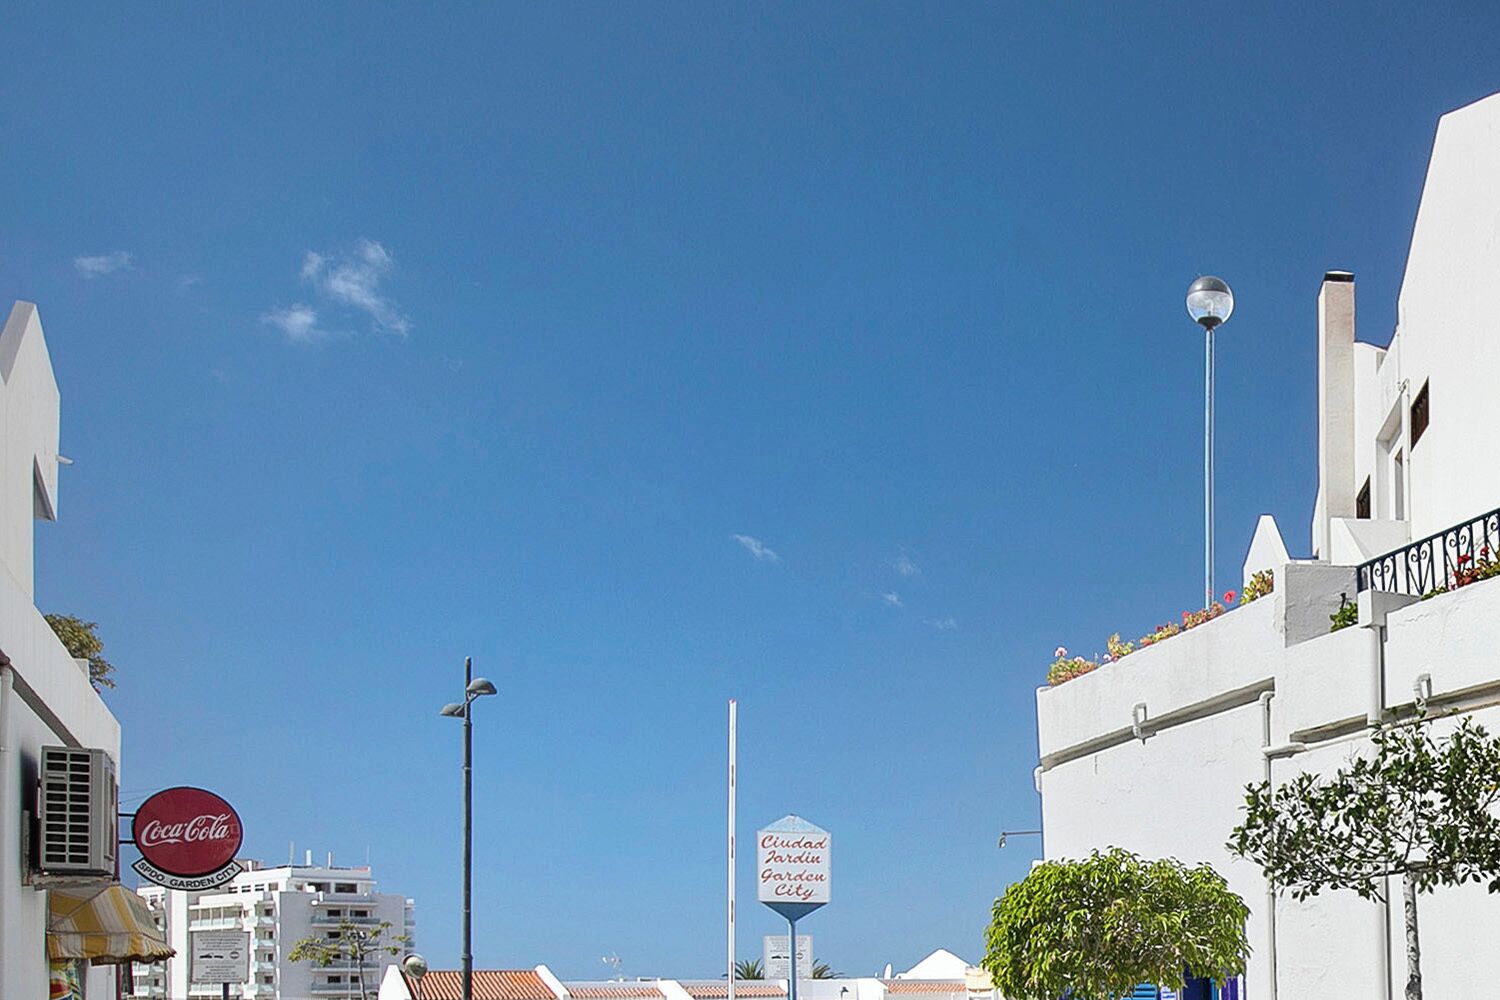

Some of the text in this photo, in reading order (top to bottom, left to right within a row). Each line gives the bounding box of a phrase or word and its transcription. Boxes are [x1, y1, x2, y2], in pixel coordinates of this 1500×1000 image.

[141, 813, 231, 846] Coca-Cola
[761, 835, 827, 849] Ciudad
[169, 878, 215, 888] GARDEN
[216, 864, 237, 882] CITY
[761, 868, 826, 883] Garden
[775, 884, 815, 900] City
